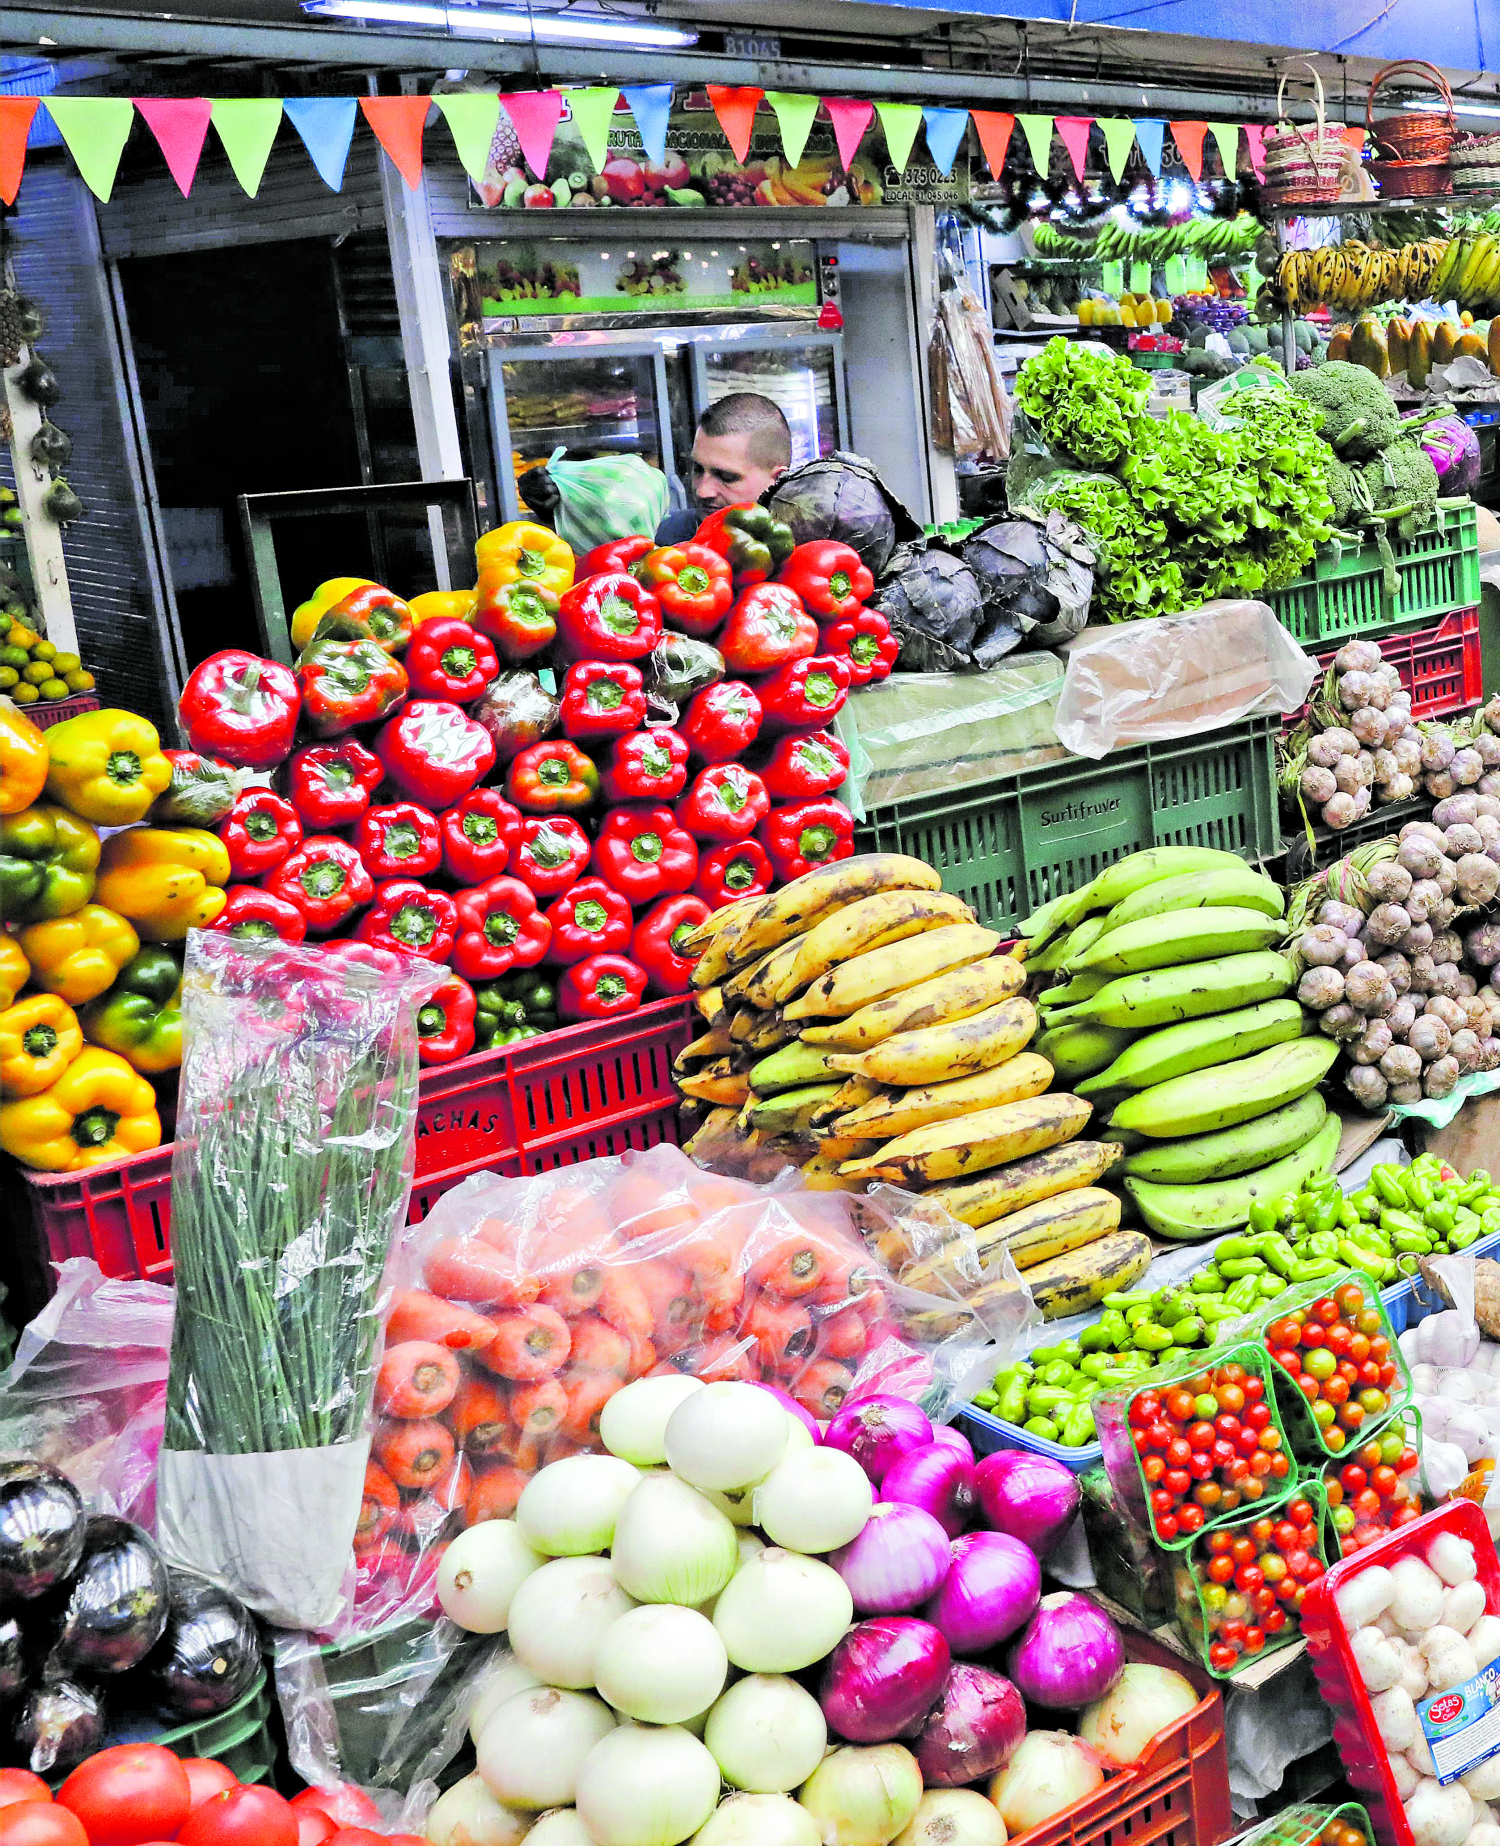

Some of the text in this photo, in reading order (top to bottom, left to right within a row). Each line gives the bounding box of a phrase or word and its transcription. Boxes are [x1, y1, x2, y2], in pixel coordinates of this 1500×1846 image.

[607, 131, 643, 148] RUTA
[905, 168, 927, 184] 375
[886, 190, 959, 201] LOCAL 81 045 046
[1041, 798, 1121, 827] Surtifruver
[1430, 1696, 1460, 1719] Setas
